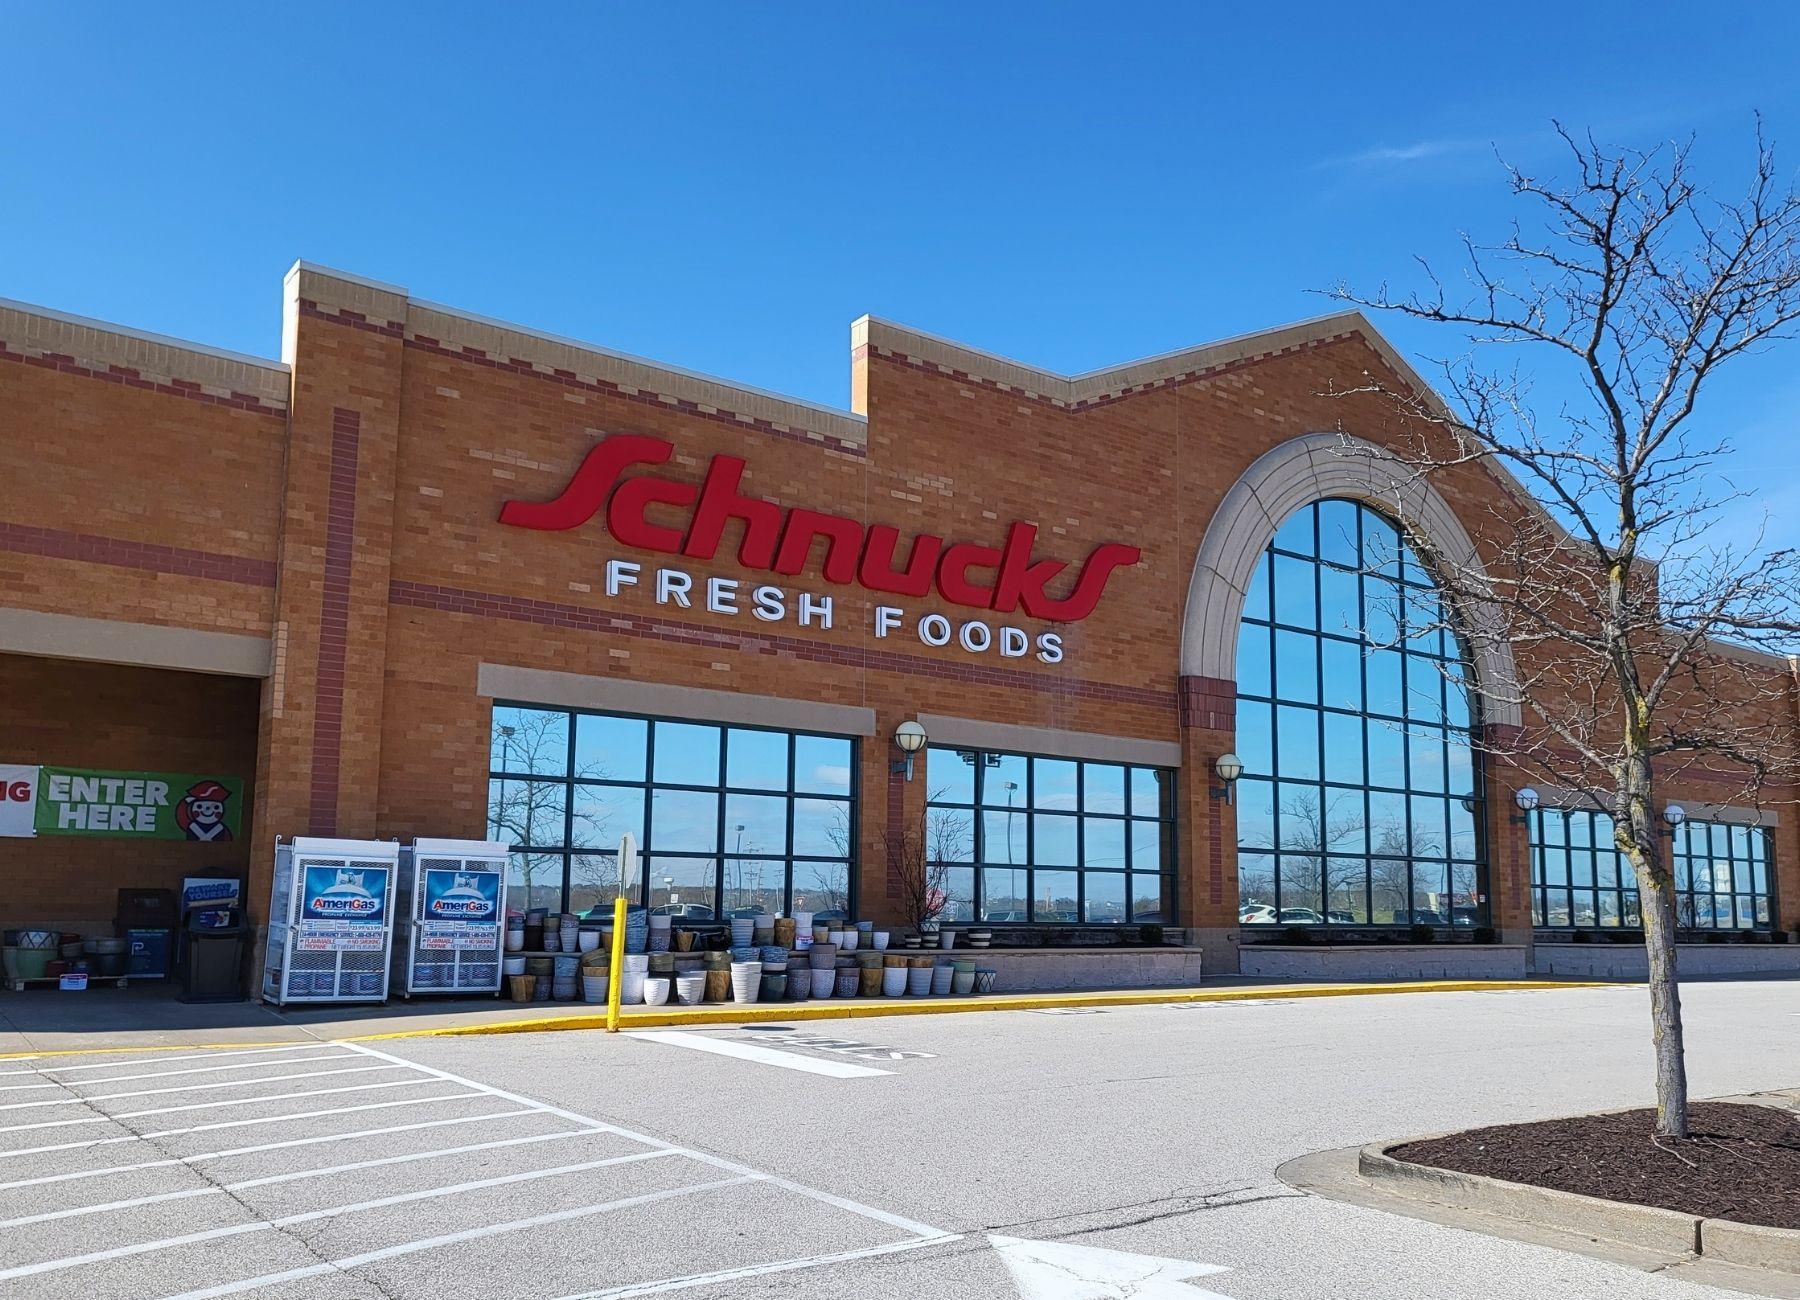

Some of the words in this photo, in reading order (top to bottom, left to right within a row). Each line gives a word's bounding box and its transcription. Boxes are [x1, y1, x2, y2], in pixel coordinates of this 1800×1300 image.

[499, 434, 1141, 622] Schnucks
[605, 559, 833, 630] FRESH
[874, 606, 1064, 664] FOODS
[48, 775, 169, 806] ENTER
[57, 803, 157, 832] HERE
[313, 898, 376, 910] AmeriGas
[433, 900, 489, 911] AmeriGas
